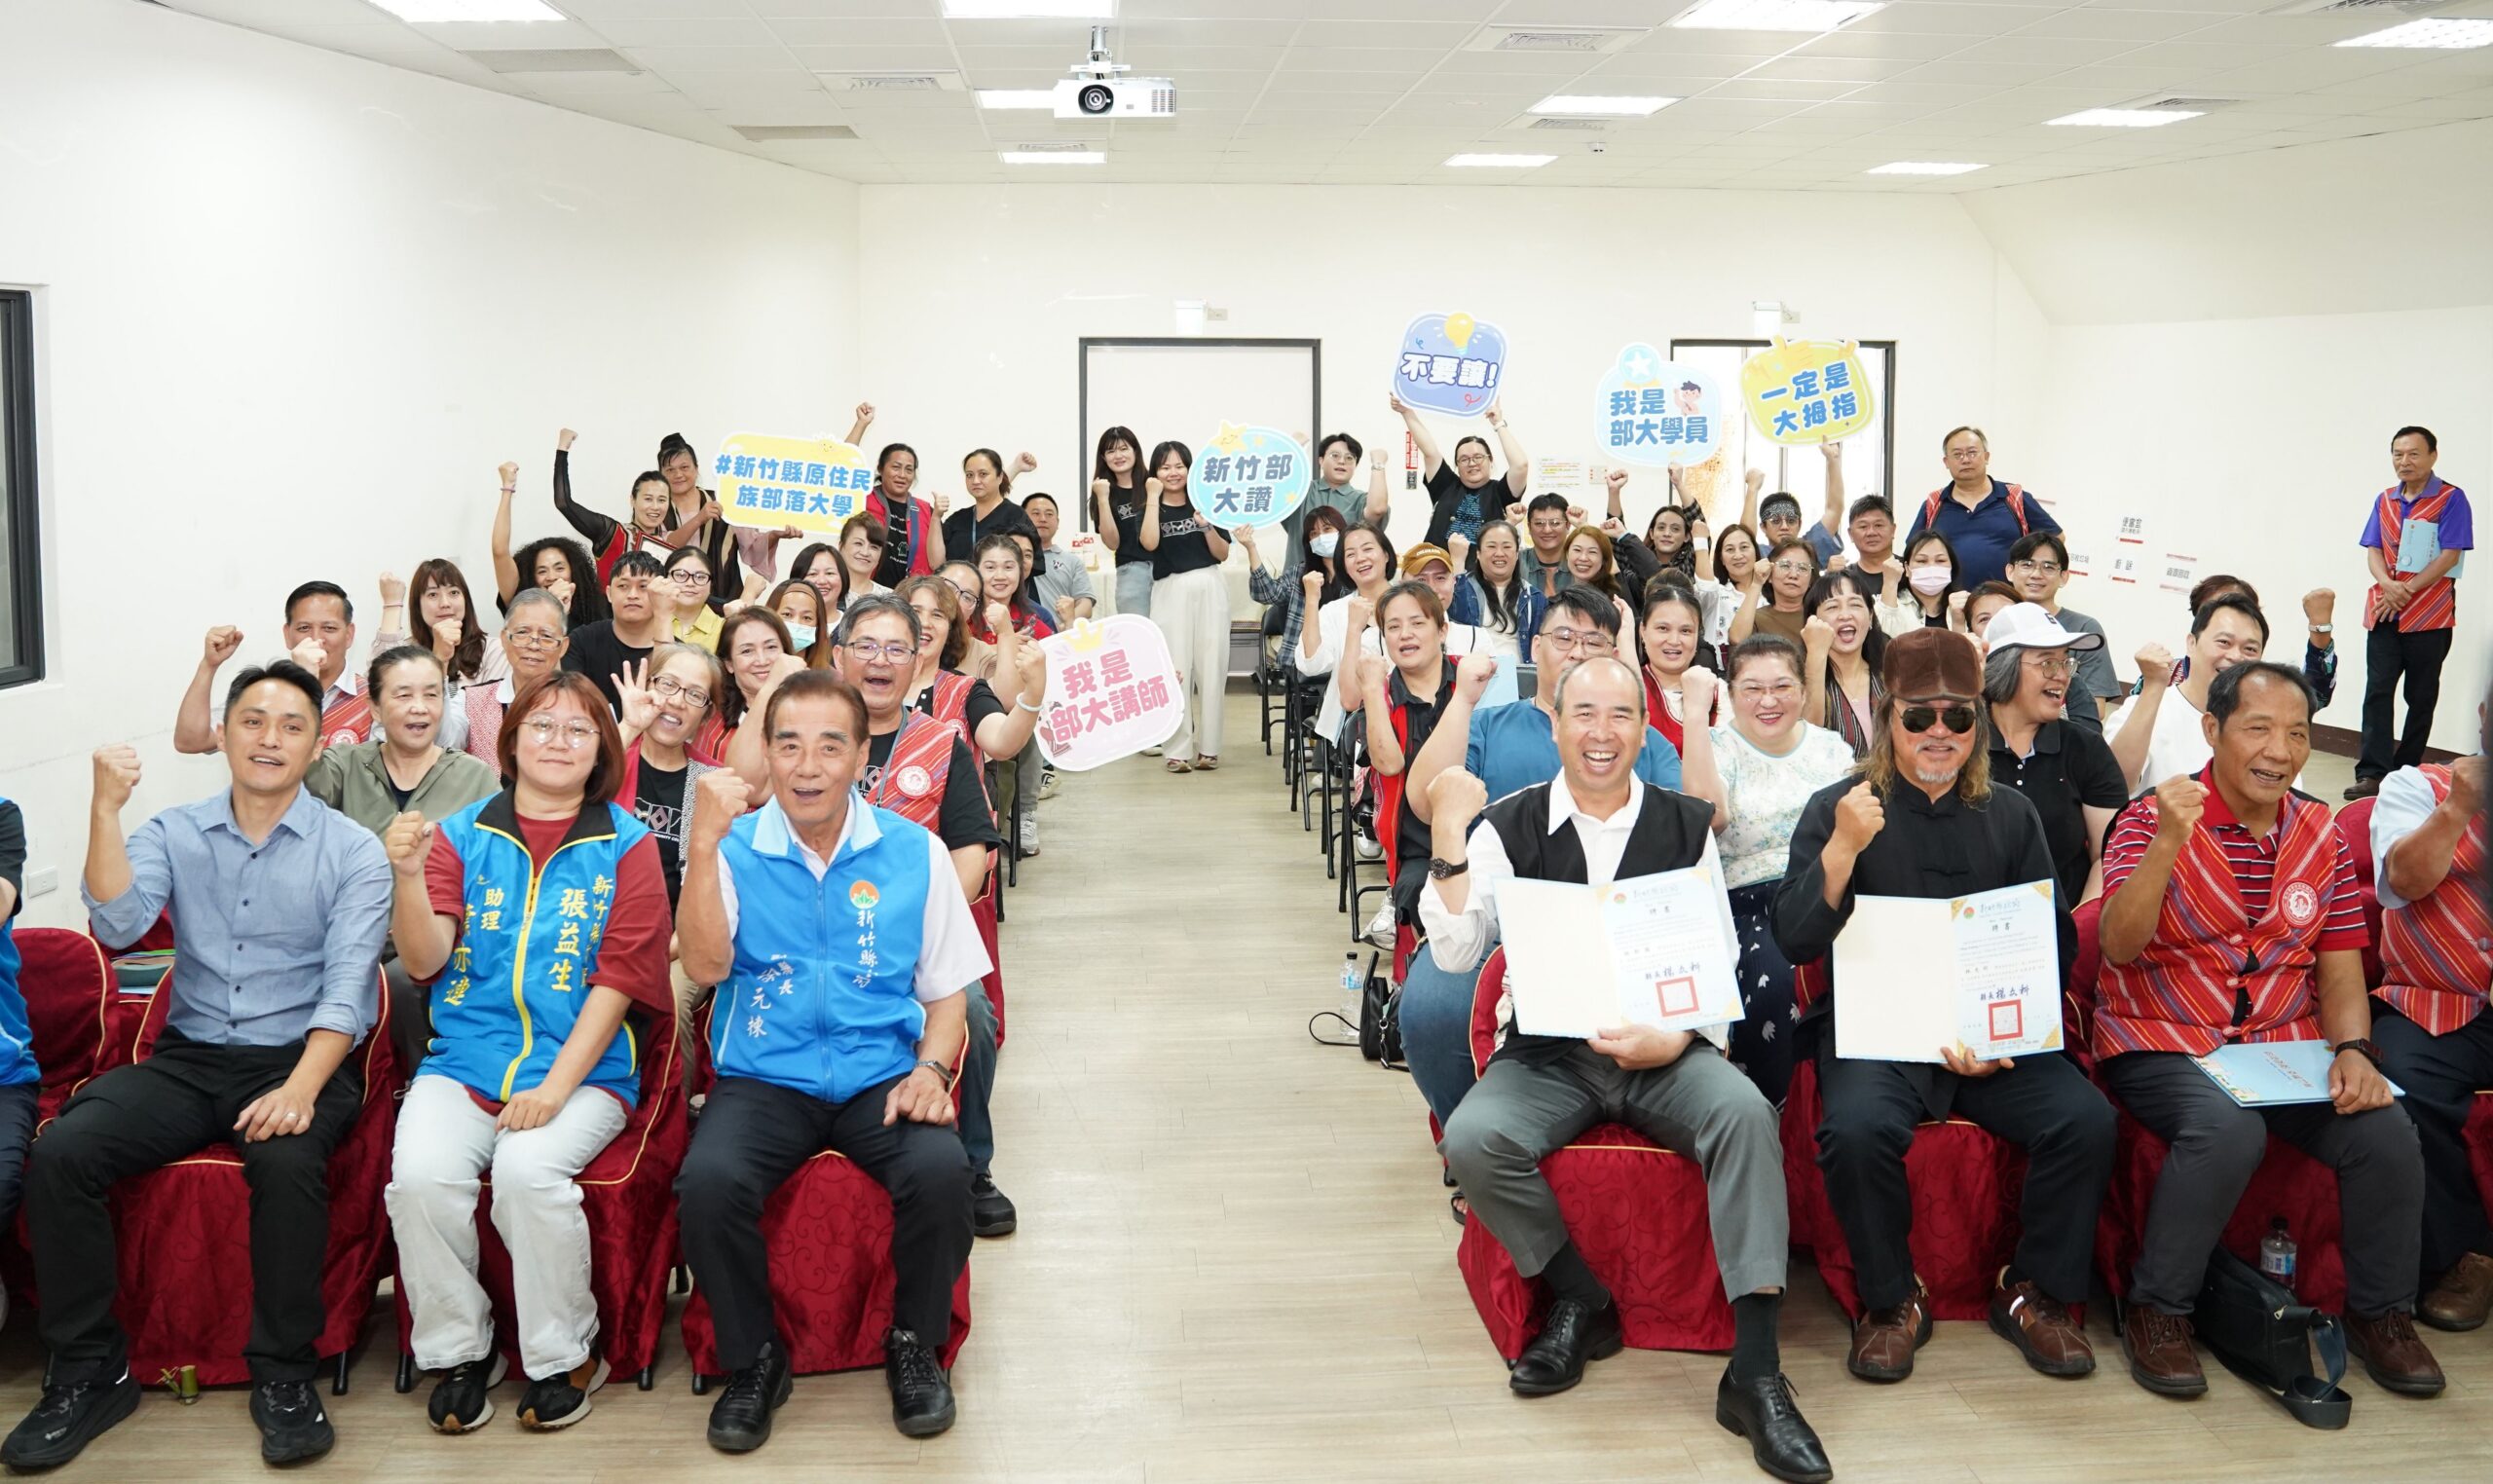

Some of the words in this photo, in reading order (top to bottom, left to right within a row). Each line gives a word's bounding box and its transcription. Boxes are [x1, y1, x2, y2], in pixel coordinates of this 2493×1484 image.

[1760, 361, 1851, 400] 一定是
[1610, 389, 1665, 417] 我是
[1773, 391, 1857, 436] 大拇指
[1610, 417, 1709, 446] 部大學員
[715, 454, 872, 492] #新竹縣原住民
[1203, 454, 1293, 483] 新竹部
[736, 484, 854, 517] 族部落大學
[1213, 486, 1273, 514] 大讚
[1061, 649, 1133, 700] 我是
[1050, 675, 1170, 743] 部大講師
[548, 888, 589, 992] 張益生
